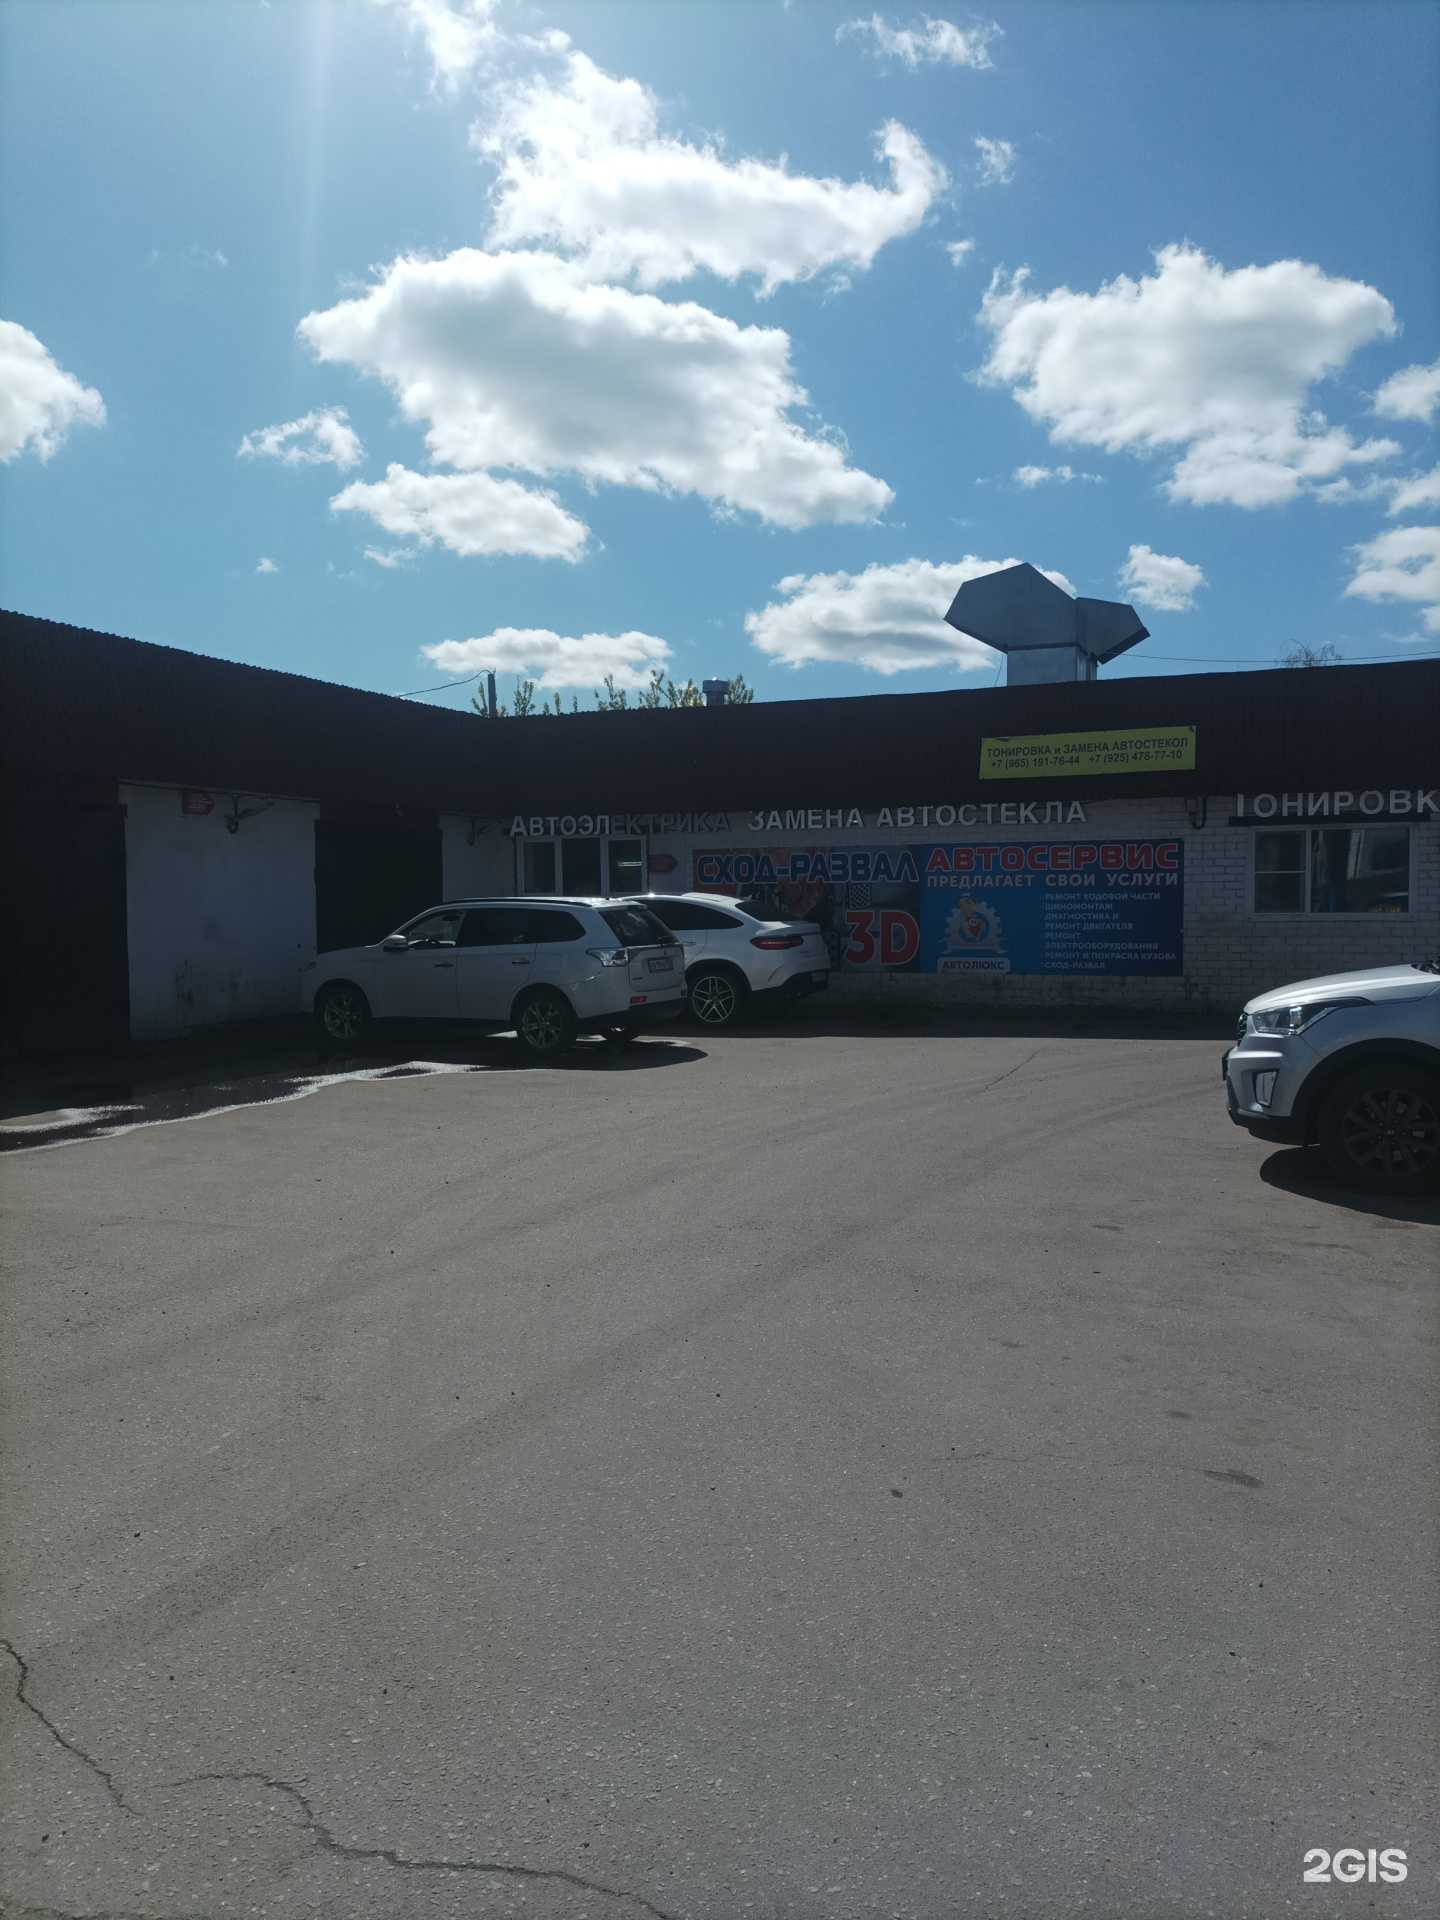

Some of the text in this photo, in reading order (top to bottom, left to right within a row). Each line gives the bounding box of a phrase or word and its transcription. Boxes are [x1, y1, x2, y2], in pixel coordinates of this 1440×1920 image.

[986, 746, 1050, 759] ТОНИРОВКА
[1063, 742, 1110, 754] ЗАМЕНА
[1112, 737, 1188, 751] АВТОСТЕКОЛ
[1089, 754, 1101, 764] +7
[509, 810, 732, 837] АВТОЭЛЕКТРИКА
[750, 800, 1088, 832] ЗАМЕНА АВТОСТЕКЛА
[697, 850, 920, 884] СХОД-РАЗВАЛ
[924, 842, 1180, 873] АВТОСЕРВИС
[927, 872, 1178, 889] ПРЕДЛАГАЕТ СВОИ УСЛУГИ
[846, 909, 920, 965] 3D
[942, 959, 1006, 971] АВТОЛЮКС
